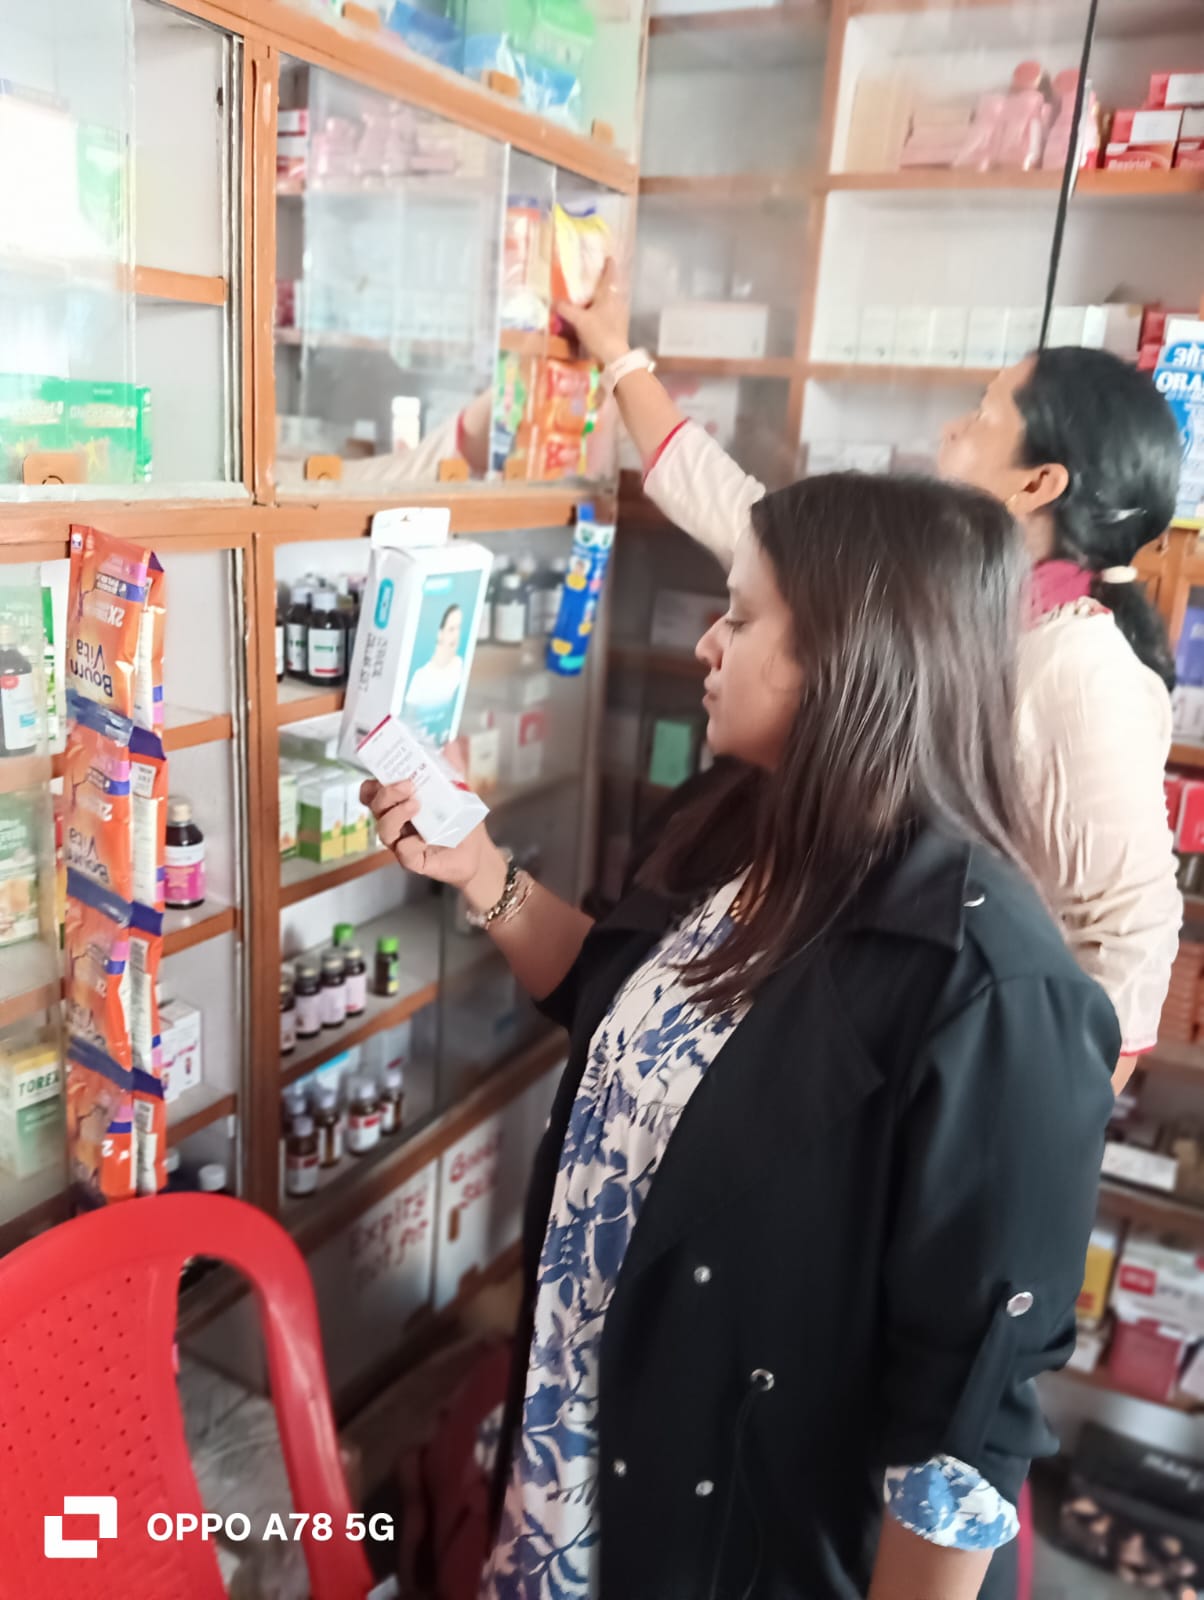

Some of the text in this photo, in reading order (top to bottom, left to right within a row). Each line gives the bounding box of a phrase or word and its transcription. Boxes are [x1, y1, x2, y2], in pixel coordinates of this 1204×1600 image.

[1155, 370, 1204, 393] ORA
[76, 638, 105, 671] Vita
[69, 658, 113, 698] Bourn
